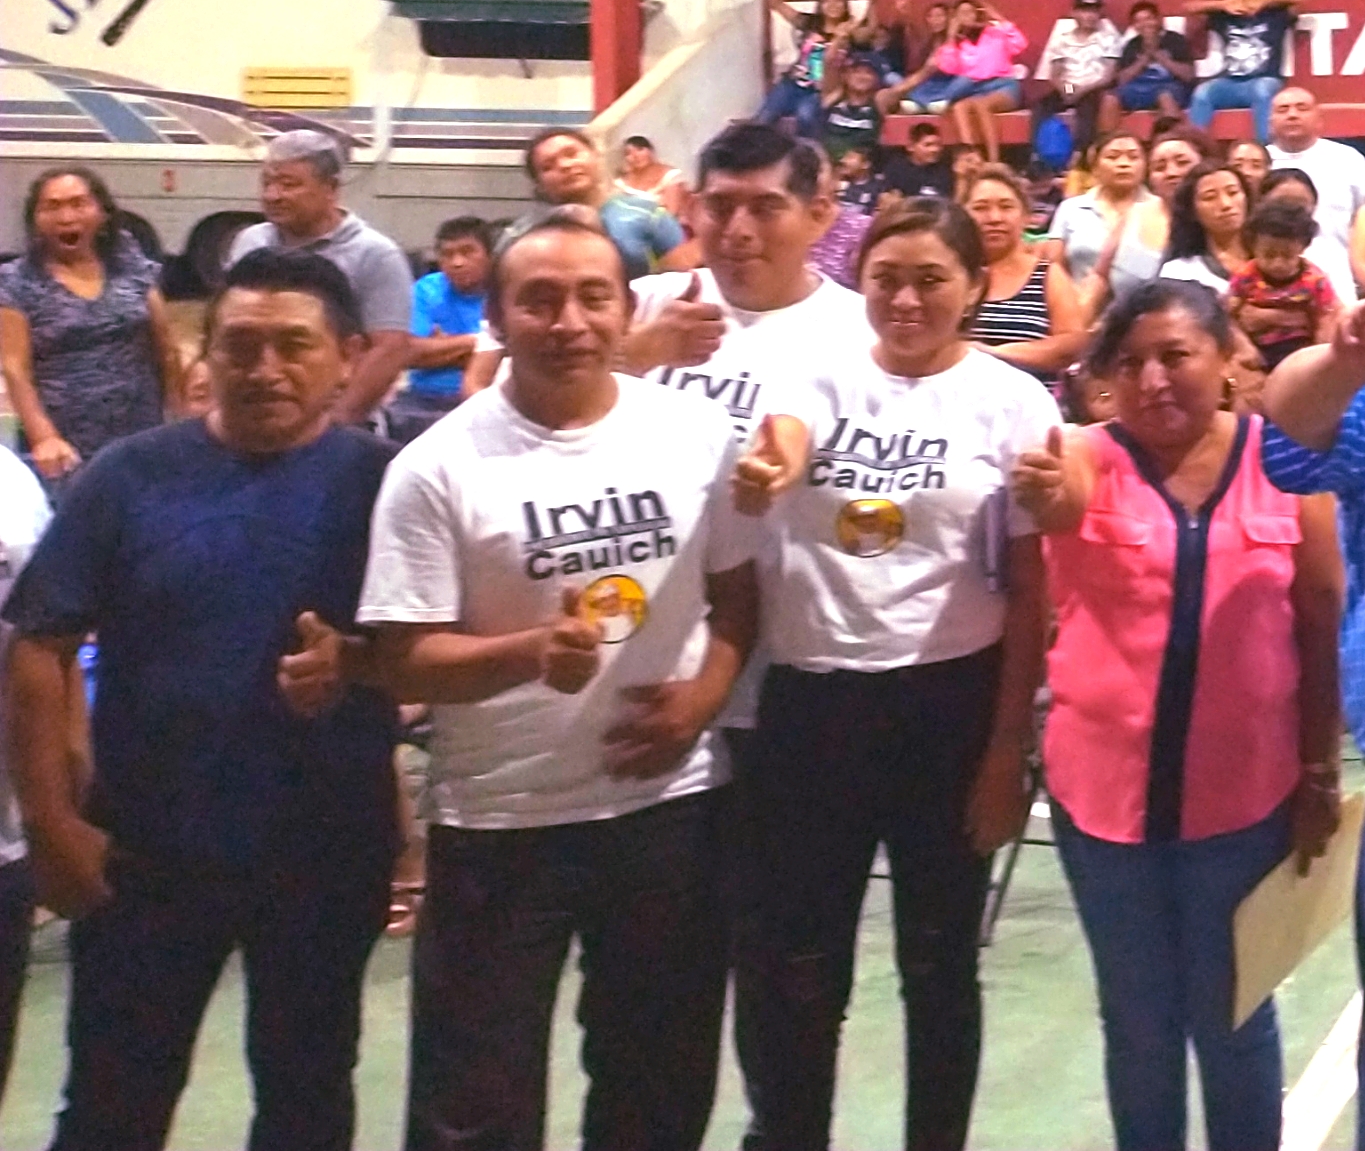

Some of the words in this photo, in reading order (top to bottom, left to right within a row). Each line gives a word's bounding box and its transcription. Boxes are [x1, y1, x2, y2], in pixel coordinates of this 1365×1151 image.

[825, 417, 948, 461] Irvin
[808, 458, 946, 493] Cauich
[522, 487, 667, 540] Irvin
[526, 529, 676, 580] Cauich
